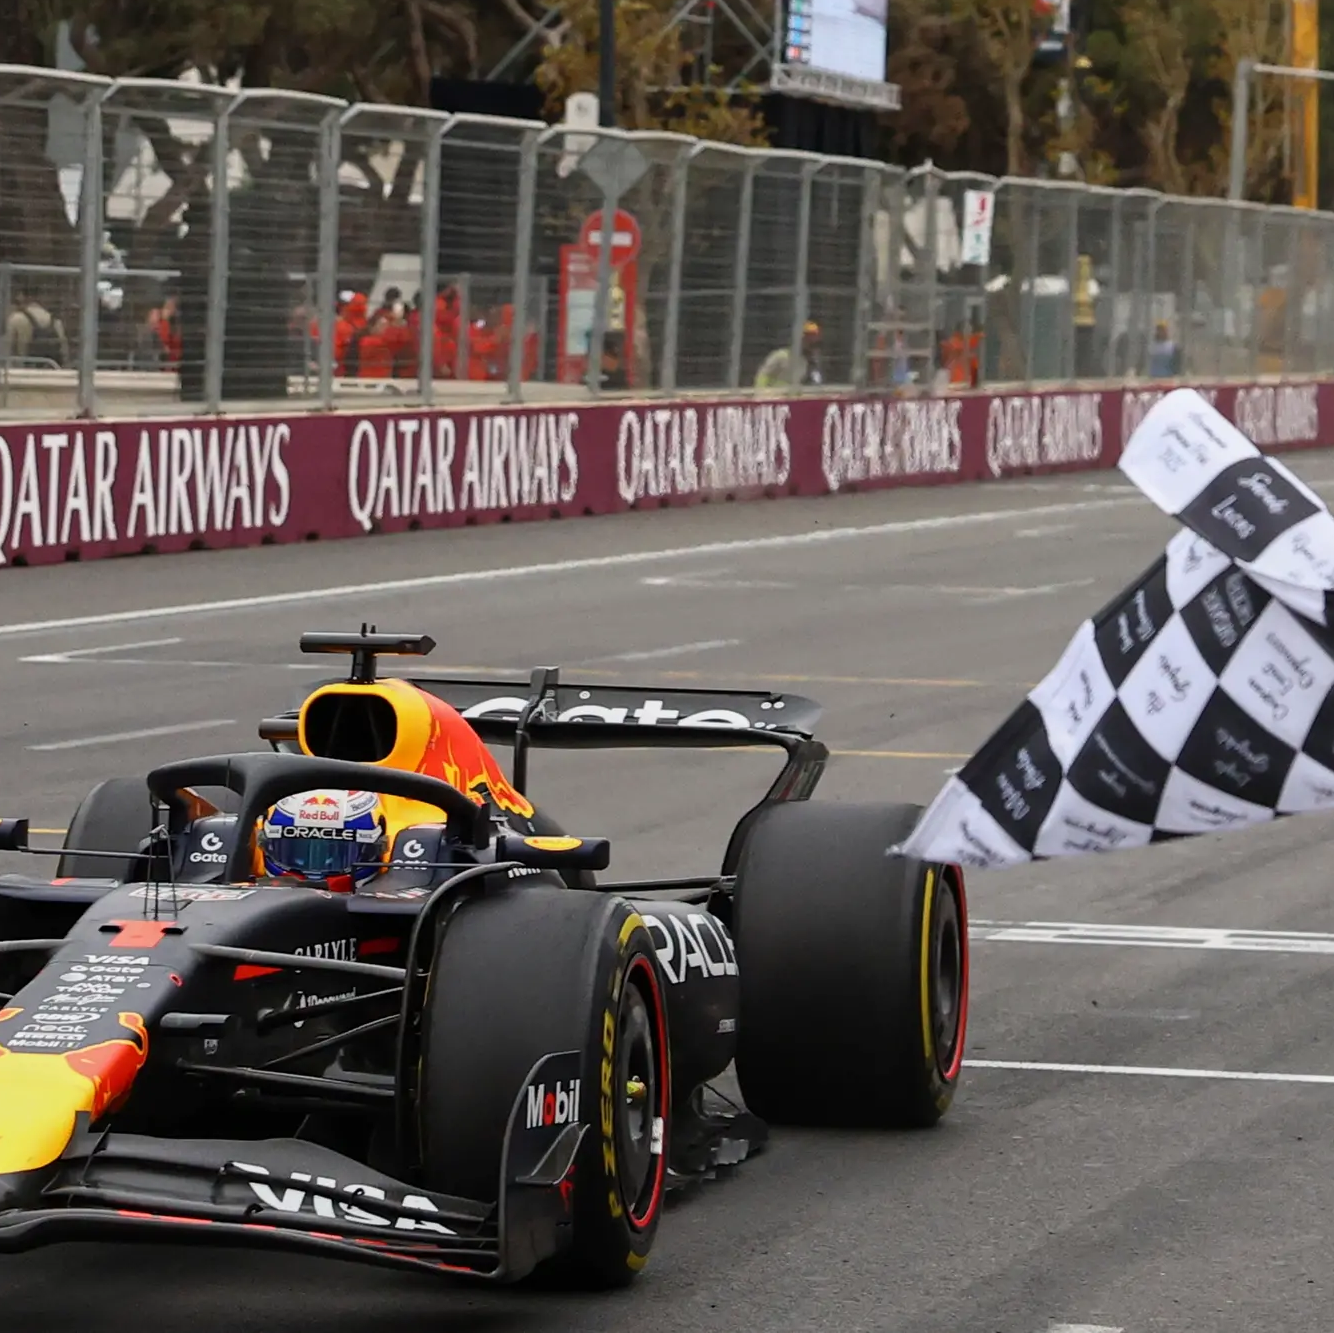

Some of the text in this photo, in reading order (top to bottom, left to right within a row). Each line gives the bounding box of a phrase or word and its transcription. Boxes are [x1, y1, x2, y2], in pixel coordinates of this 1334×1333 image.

[617, 406, 698, 504] QATAR
[348, 411, 580, 531] QATAR AIRWAYS
[127, 422, 292, 539] AIRWAYS
[299, 810, 340, 821] Red Bull
[283, 827, 354, 840] ORACLE
[190, 852, 228, 864] Gate
[83, 954, 150, 965] VISA
[88, 975, 140, 983] AT&T
[56, 986, 125, 994] TRADE
[38, 1005, 109, 1013] CARLYLE
[23, 1024, 89, 1033] neat.
[7, 1039, 62, 1048] Mobil
[526, 1078, 581, 1129] Mobil
[231, 1161, 457, 1235] VISA
